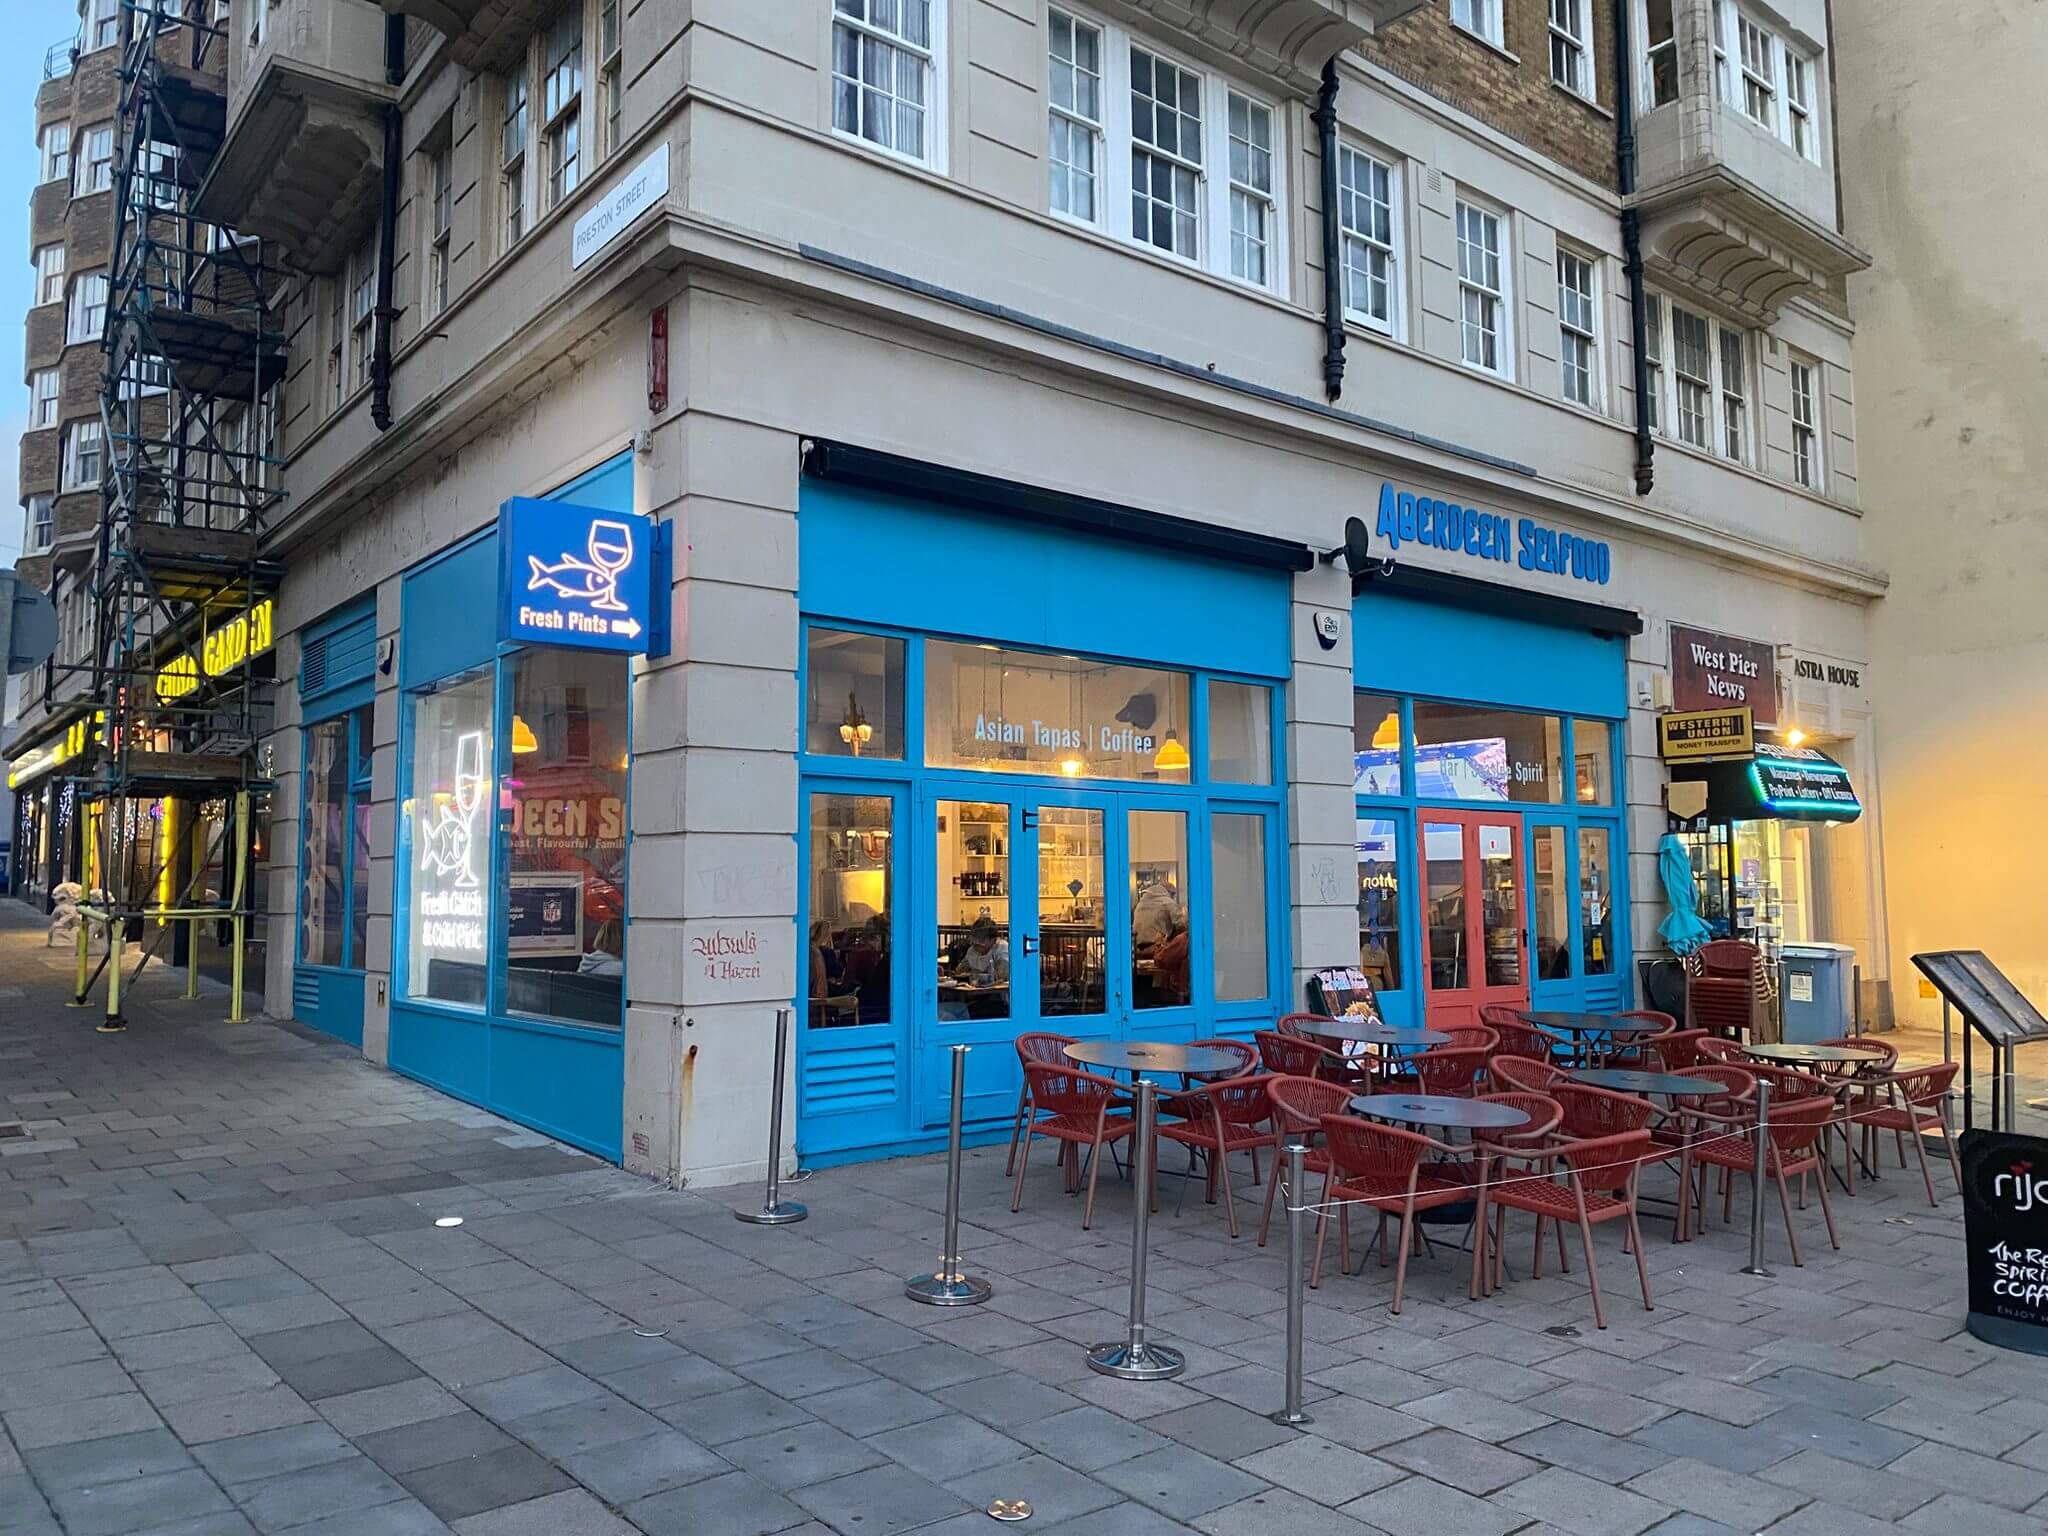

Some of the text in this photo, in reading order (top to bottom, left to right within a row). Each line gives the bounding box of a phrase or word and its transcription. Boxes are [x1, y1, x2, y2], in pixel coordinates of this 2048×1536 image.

[576, 176, 648, 251] PRESTON STREET
[1376, 480, 1610, 585] ABERDEEN SEAFOOD
[520, 605, 607, 633] Fresh Pints
[1690, 643, 1758, 678] West Pier
[1795, 658, 1860, 688] ASTRA HOUSE
[1707, 674, 1745, 701] News
[975, 713, 1152, 754] Asian Tapas Coffee
[1667, 716, 1731, 731] WESTERN
[1687, 727, 1731, 739] UNION
[1676, 738, 1741, 750] MONEY TRANSFER
[1515, 761, 1543, 785] Spirit
[599, 797, 626, 838] S
[1988, 1240, 2022, 1263] The
